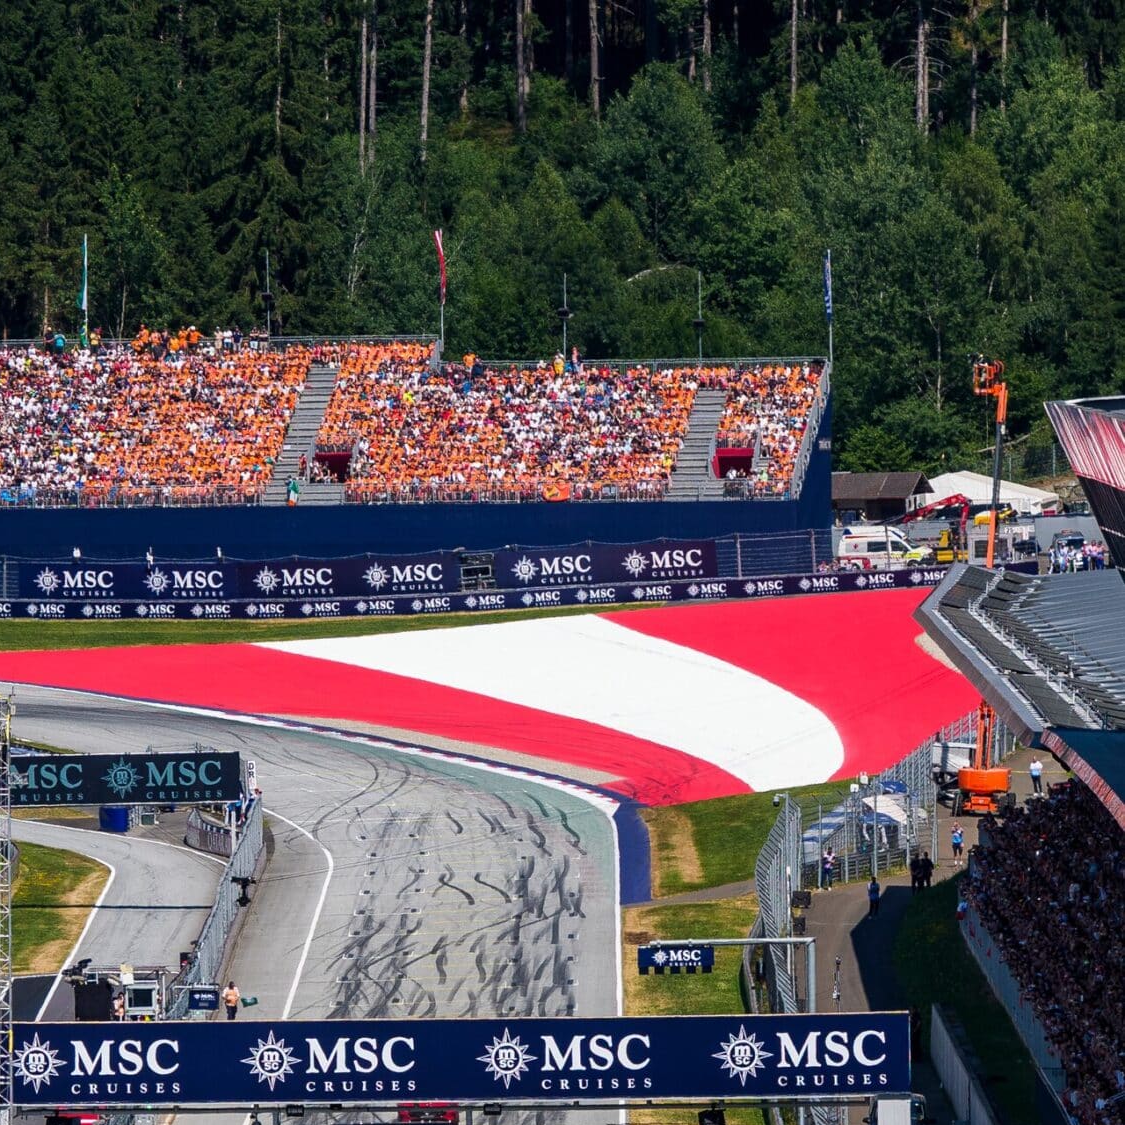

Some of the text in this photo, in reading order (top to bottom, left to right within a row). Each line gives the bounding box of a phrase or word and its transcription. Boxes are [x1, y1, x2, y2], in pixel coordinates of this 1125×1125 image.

[652, 549, 702, 568] MSC
[540, 555, 591, 575] MSC
[282, 568, 332, 586] MSC
[392, 563, 442, 582] MSC
[63, 571, 114, 588] MSC
[172, 571, 223, 588] MSC
[541, 576, 592, 584] CRUISES
[812, 577, 838, 588] MSC
[869, 573, 894, 585] MSC
[646, 585, 672, 596] MSC
[701, 583, 727, 593] MSC
[757, 580, 783, 592] MSC
[535, 591, 560, 602] MSC
[590, 588, 615, 599] MSC
[369, 600, 395, 610] MSC
[425, 597, 450, 608] MSC
[479, 595, 505, 606] MSC
[40, 604, 65, 613] MSC
[95, 604, 121, 614] MSC
[150, 604, 175, 614] MSC
[205, 604, 231, 614] MSC
[259, 604, 285, 614] MSC
[315, 602, 340, 612] MSC
[9, 763, 83, 789] MSC
[146, 760, 222, 789] MSC
[146, 789, 223, 799] CRUISES
[669, 950, 701, 961] MSC
[541, 1034, 651, 1070] MSC
[776, 1030, 887, 1068] MSC
[71, 1039, 180, 1076] MSC
[306, 1037, 416, 1074] MSC
[542, 1077, 653, 1089] CRUISES
[778, 1074, 888, 1086] CRUISES
[71, 1083, 181, 1094] CRUISES
[306, 1080, 416, 1092] CRUISES
